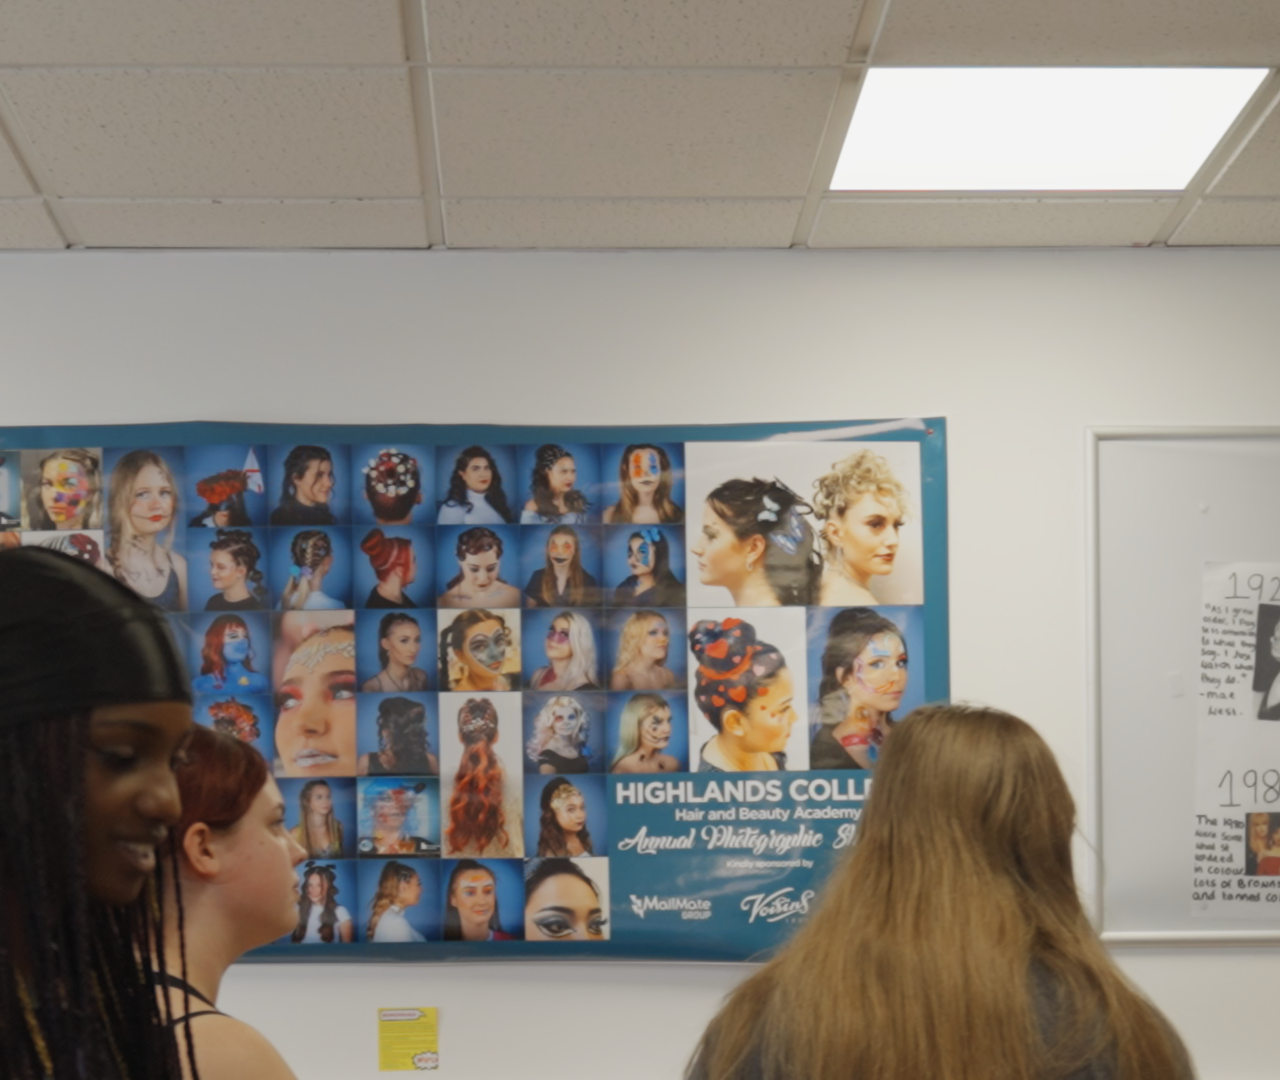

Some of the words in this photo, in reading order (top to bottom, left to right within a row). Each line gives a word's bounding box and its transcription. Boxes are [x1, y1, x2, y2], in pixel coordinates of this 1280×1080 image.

[616, 779, 783, 805] HIGHLANDS
[675, 809, 705, 822] Hair
[707, 807, 736, 821] and
[739, 807, 790, 822] Beauty
[793, 805, 863, 821] Academy
[1196, 814, 1218, 827] The
[618, 825, 696, 855] Annual
[701, 824, 824, 856] Photographic
[726, 860, 754, 869] Kindly
[756, 859, 801, 870] sponsored
[803, 858, 814, 868] by
[1192, 890, 1216, 901] and
[642, 896, 712, 911] MailMate
[740, 887, 815, 924] Voisins
[680, 910, 712, 920] GROUP
